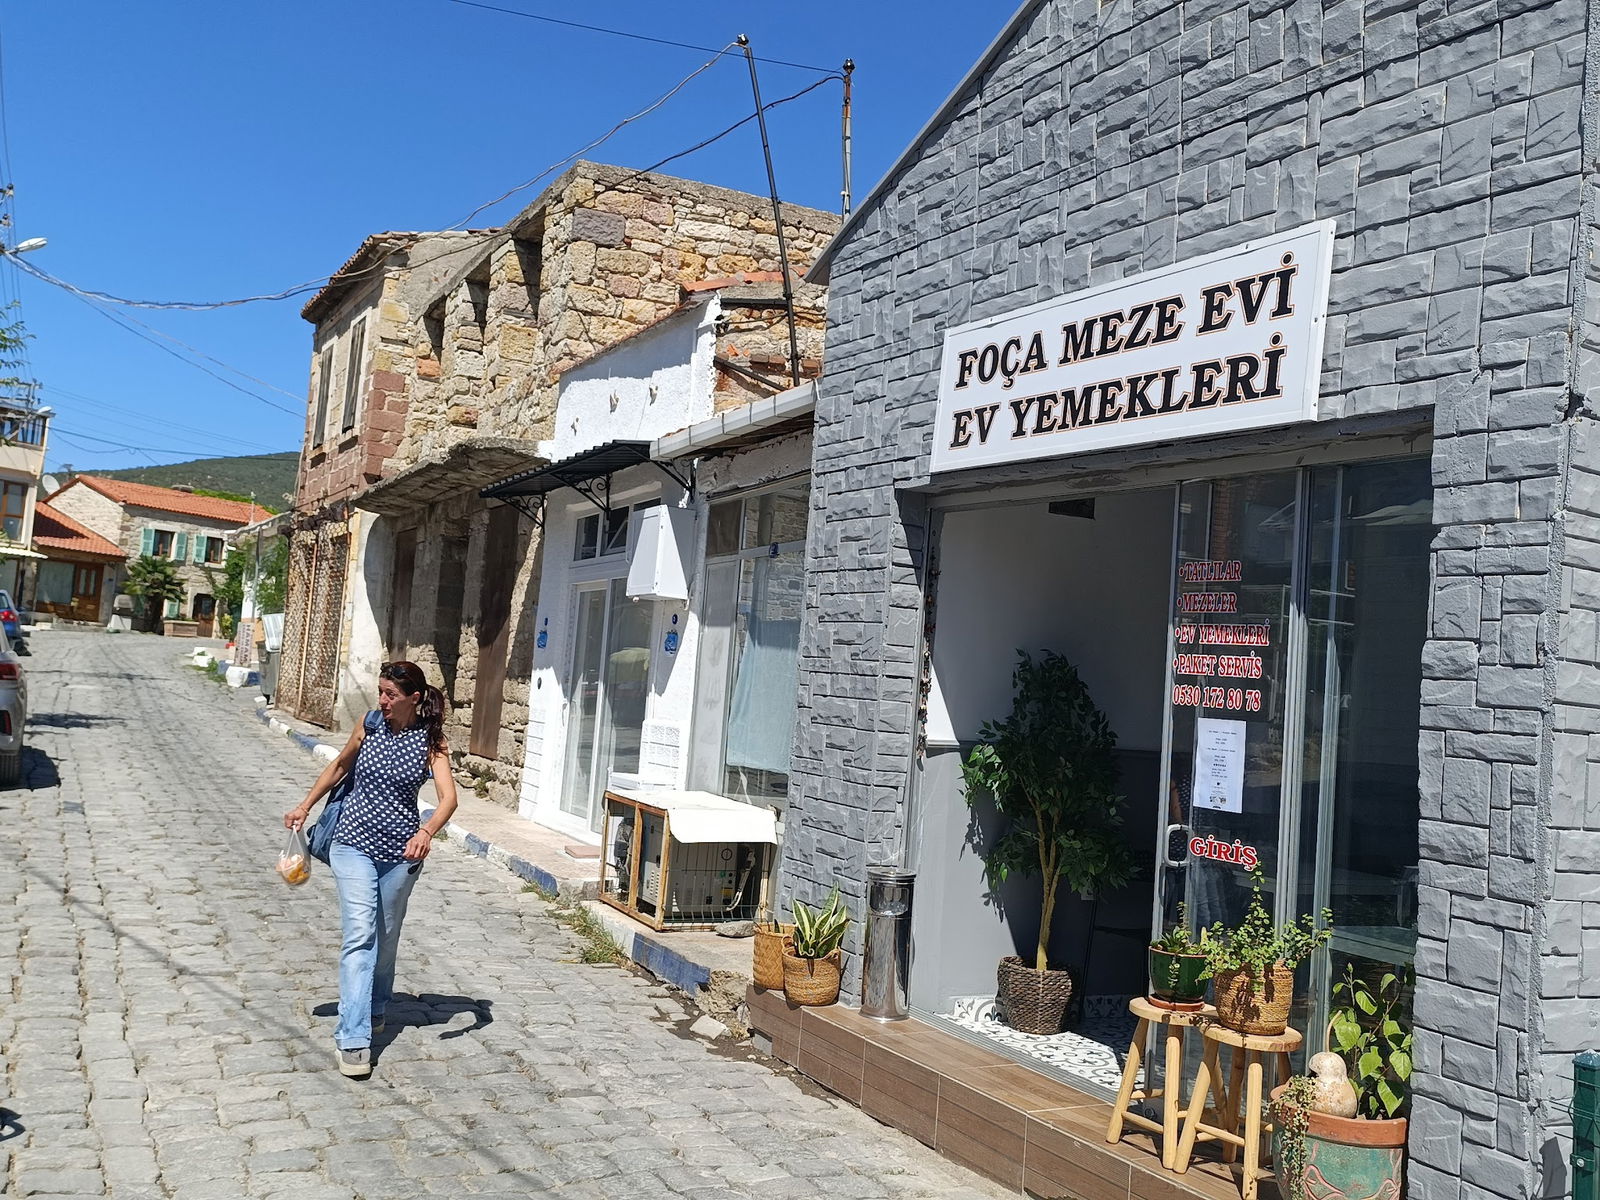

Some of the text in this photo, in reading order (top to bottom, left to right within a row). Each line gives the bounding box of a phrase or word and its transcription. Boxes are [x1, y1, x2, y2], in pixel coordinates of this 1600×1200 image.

[954, 251, 1299, 390] FOÇA MEZE EVİ
[949, 332, 1289, 450] EV YEMEKLERİ
[1184, 560, 1242, 582] TATLILAR
[1181, 592, 1238, 613] MEZELER
[243, 624, 251, 662] HAMAM
[1179, 618, 1270, 646] EV YEMEKLERİ
[1177, 650, 1262, 679] PAKET SERVİS
[1173, 684, 1261, 712] 0530 172 80 78
[1189, 834, 1258, 872] GİRİŞ
